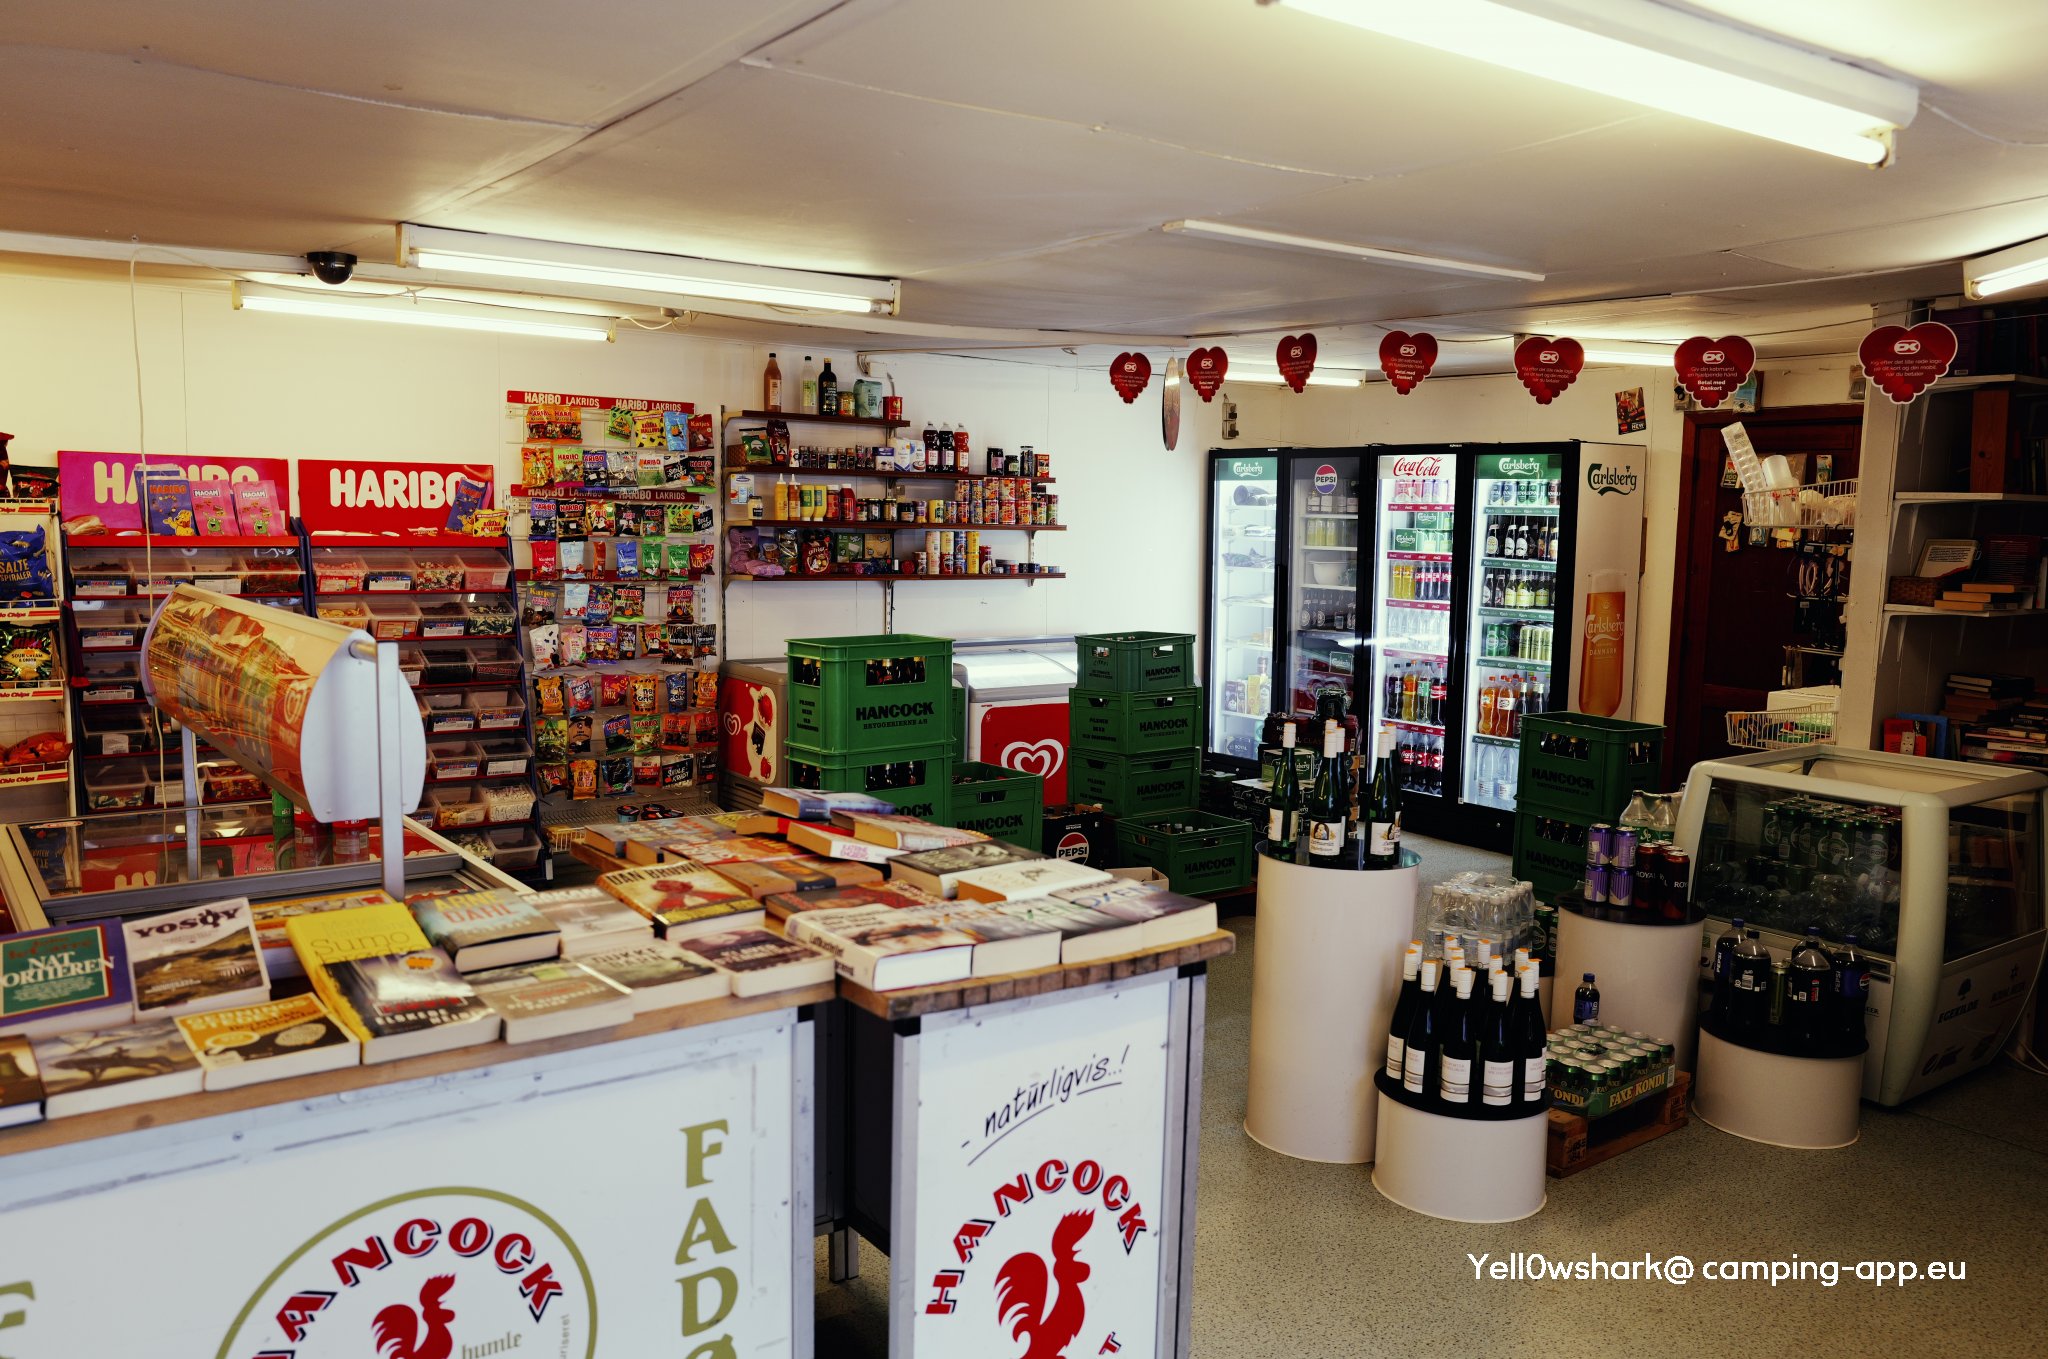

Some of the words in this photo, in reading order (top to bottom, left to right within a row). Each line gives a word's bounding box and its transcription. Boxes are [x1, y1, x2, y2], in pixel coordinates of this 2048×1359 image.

[524, 392, 561, 404] HARIBO
[566, 396, 599, 407] LAKRIDS
[616, 398, 648, 411] HARIBO
[652, 402, 681, 412] LAKRIDS
[1233, 461, 1263, 477] Carlsberg
[1393, 456, 1442, 477] Coca-Cola
[1498, 457, 1540, 477] Carlsberg
[1587, 463, 1638, 495] Carlsberg
[150, 485, 186, 494] HARIBO
[194, 489, 219, 497] MAOAM
[619, 491, 651, 500] HARIBO
[656, 492, 685, 500] LAKRIDS
[560, 503, 583, 511] HARIBO
[0, 558, 29, 574] SALTE
[1585, 613, 1625, 640] Carlsberg
[1589, 647, 1617, 656] DANMARK
[1145, 665, 1182, 678] HANCOCK
[855, 701, 935, 721] HANCOCK
[863, 719, 916, 730] BRYGGERIERNE
[1139, 718, 1189, 732] HANCOCK
[1136, 780, 1185, 796] HANCOCK
[1531, 767, 1596, 791] HANCOCK
[956, 813, 1024, 832] HANCOCK
[1058, 845, 1088, 858] PEPSI
[606, 871, 645, 886] DAN
[645, 861, 708, 880] BROWN
[1184, 856, 1237, 873] HANCOCK
[444, 903, 521, 924] DAHL
[310, 931, 410, 953] Sumo
[27, 951, 76, 970] NAT
[1608, 1087, 1634, 1109] FAXE
[1635, 1071, 1666, 1097] KONDI
[924, 1158, 1148, 1315] HANCOCK
[252, 1216, 564, 1359] ANCOCK
